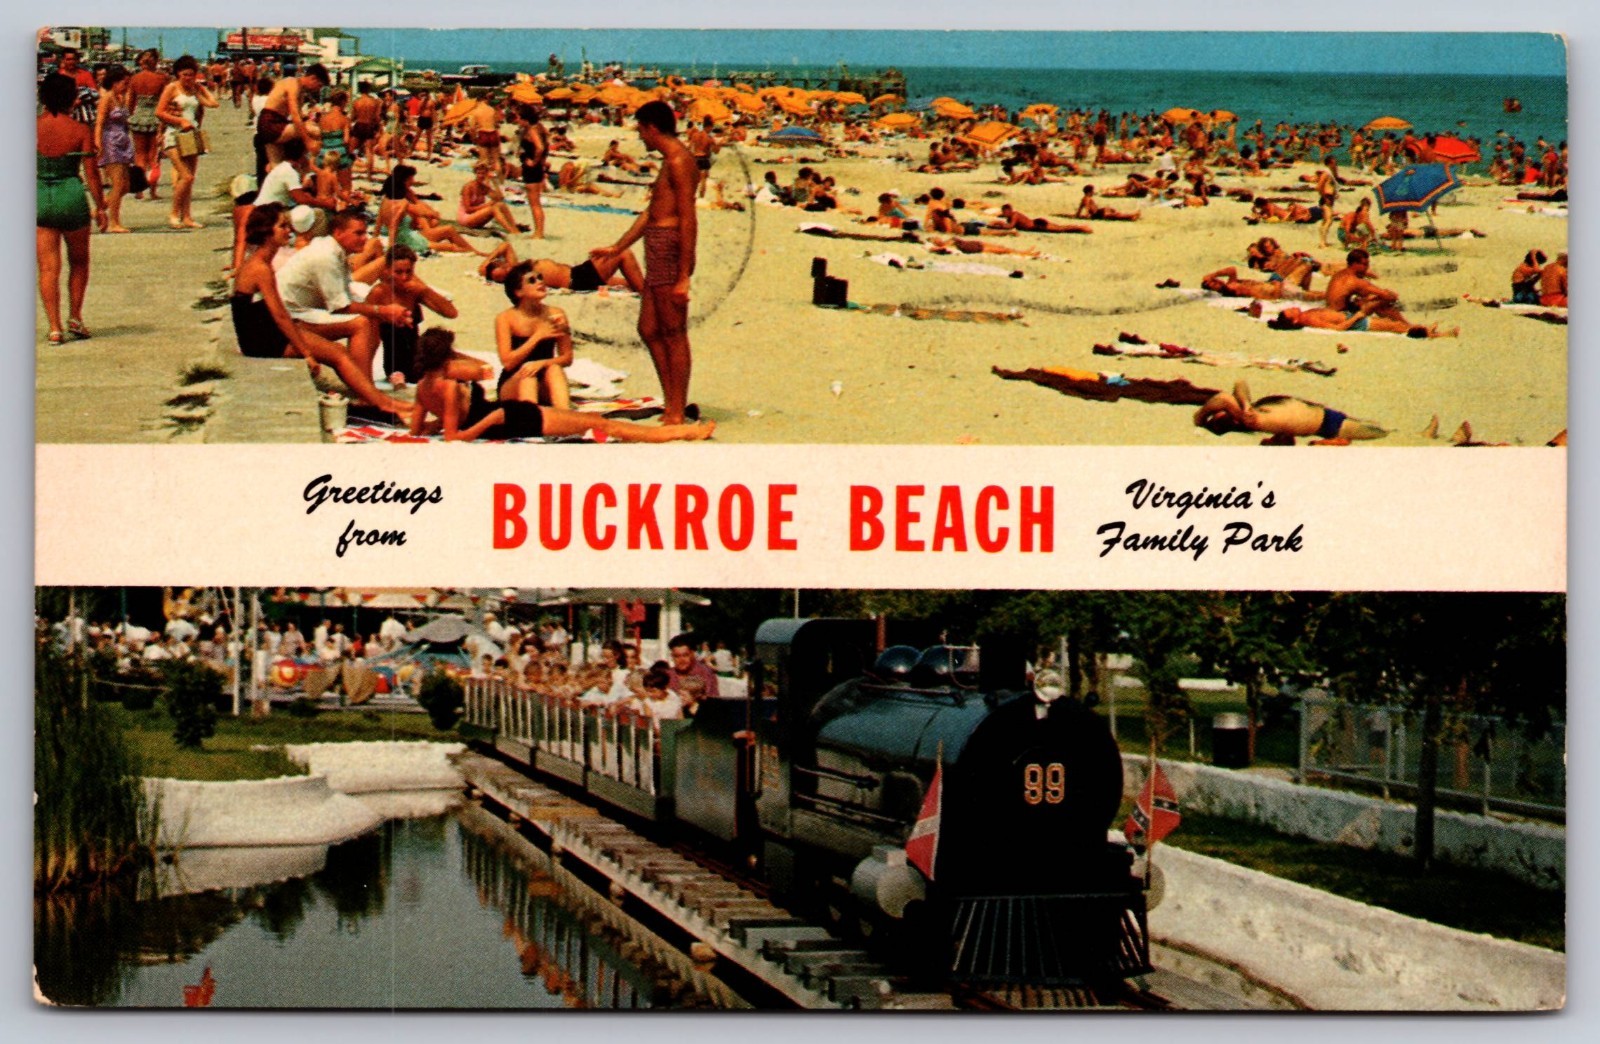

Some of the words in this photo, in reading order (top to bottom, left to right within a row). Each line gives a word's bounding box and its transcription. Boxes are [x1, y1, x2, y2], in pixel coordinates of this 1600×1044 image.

[303, 474, 443, 514] Greetings
[1125, 479, 1276, 519] Virginia's
[493, 483, 797, 551] BUCKROE
[850, 485, 1054, 553] BEACH
[336, 519, 407, 558] from
[1097, 521, 1208, 561] Family
[1222, 522, 1304, 555] Park
[1024, 762, 1065, 805] 99
